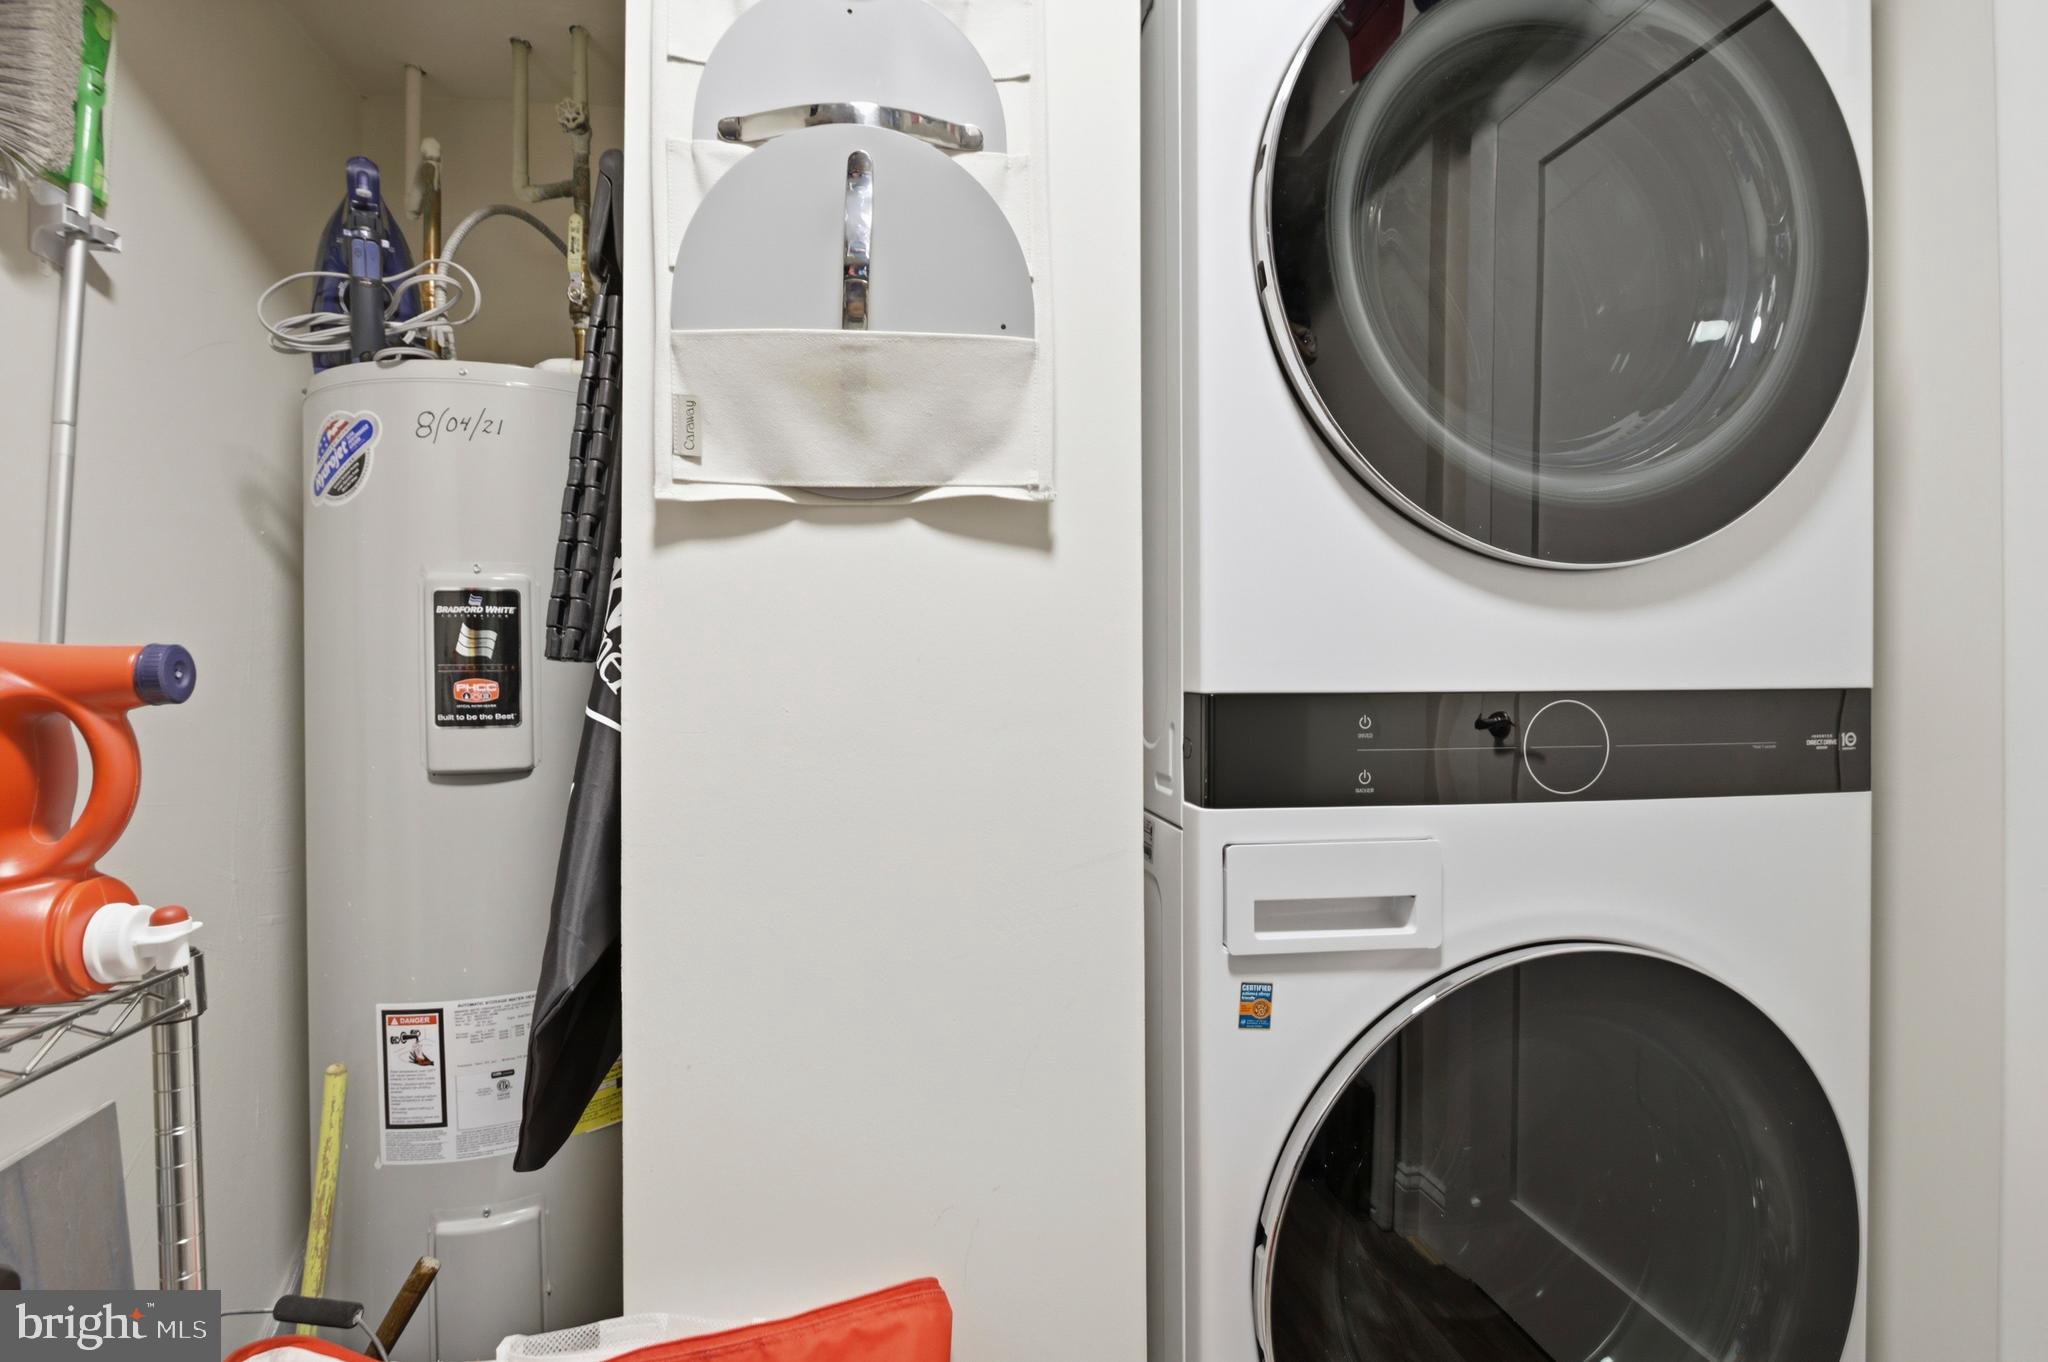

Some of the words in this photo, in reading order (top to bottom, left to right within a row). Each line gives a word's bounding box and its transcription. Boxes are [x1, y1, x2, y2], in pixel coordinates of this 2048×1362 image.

[415, 407, 504, 444] 8/04/21
[684, 400, 697, 451] Caraway
[436, 605, 483, 614] BRADFORD
[485, 605, 517, 614] WHITE
[456, 683, 497, 692] PHCC
[437, 713, 455, 721] Built
[495, 712, 515, 720] Best
[1841, 732, 1857, 746] 10
[399, 1016, 431, 1025] DANGER
